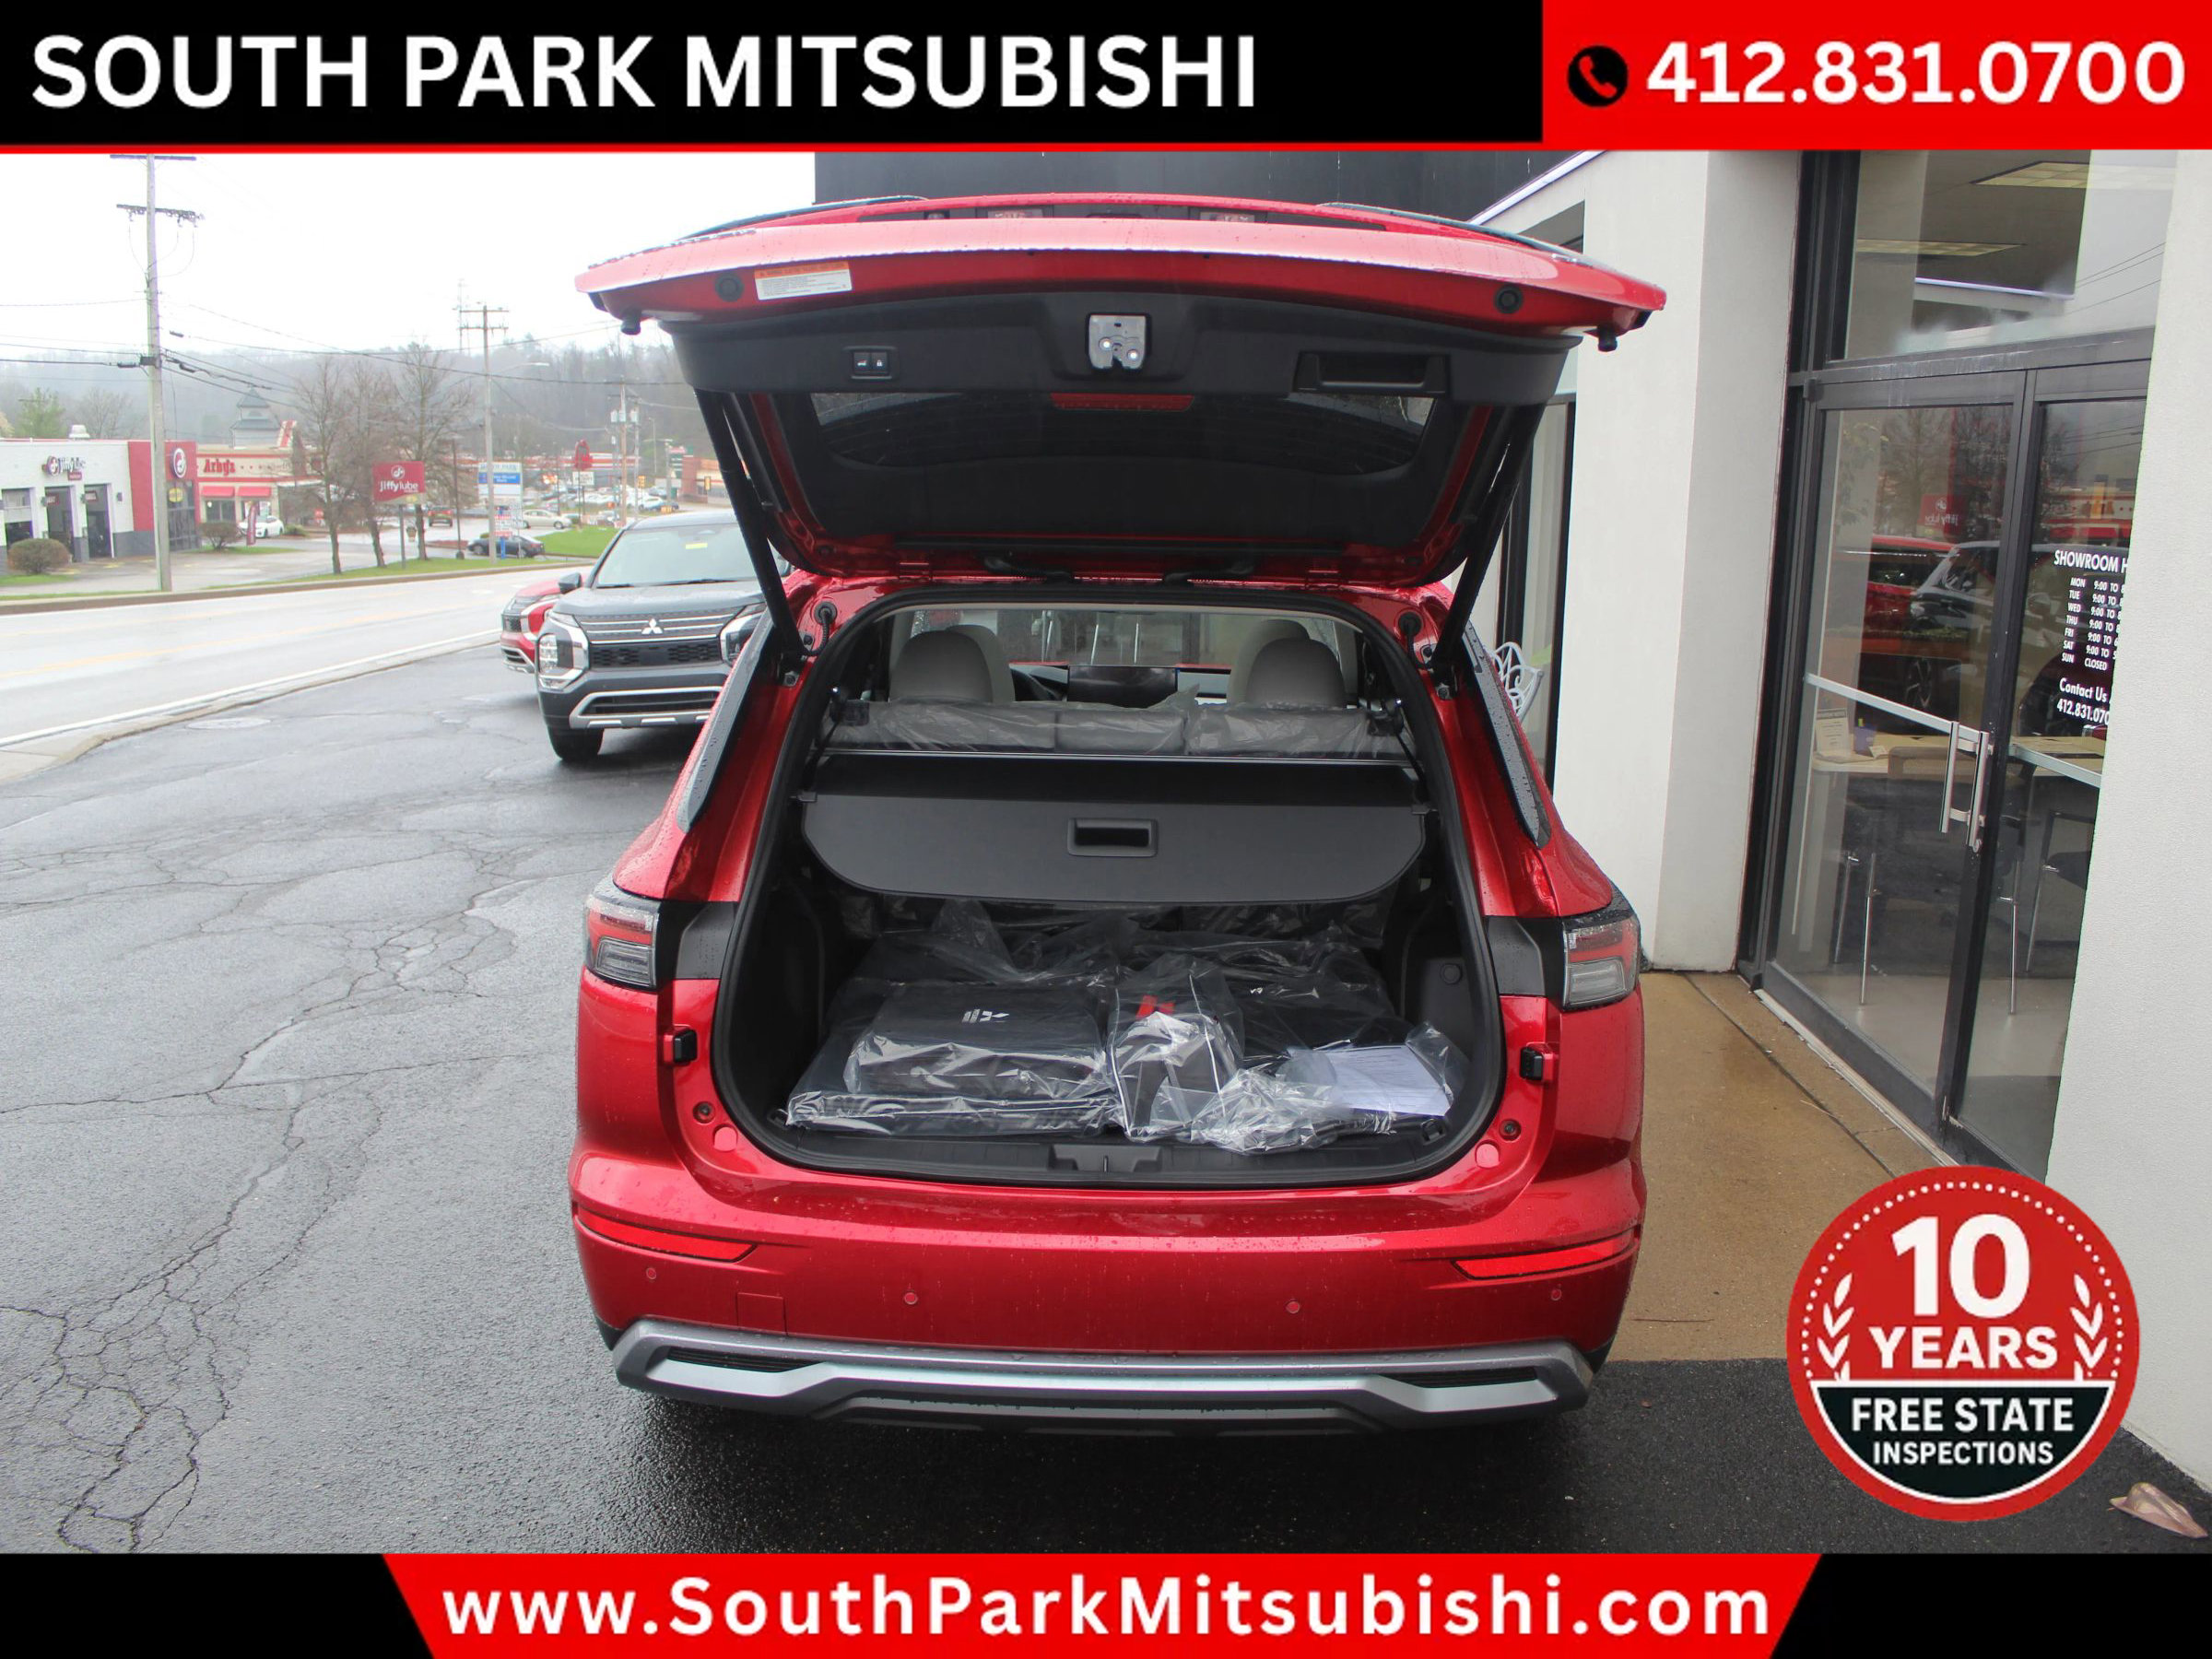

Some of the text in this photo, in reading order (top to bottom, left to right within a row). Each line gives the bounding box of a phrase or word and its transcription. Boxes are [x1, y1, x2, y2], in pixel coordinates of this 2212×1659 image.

[204, 458, 236, 476] Arby's
[2053, 550, 2119, 573] SHOWROOM
[2070, 577, 2086, 588] MON
[2094, 580, 2108, 591] 9:00
[2110, 582, 2119, 593] TO
[2069, 590, 2080, 600] TUE
[2092, 594, 2106, 605] 9:00
[2108, 595, 2117, 606] TO
[2067, 602, 2081, 613] WED
[2090, 606, 2104, 618] 9:00
[2106, 608, 2115, 619] TO
[2066, 615, 2078, 625] THU
[2089, 619, 2102, 630] 9:00
[2105, 621, 2113, 632] TO
[2065, 628, 2074, 638] FRI
[2088, 632, 2100, 643] 9:00
[2103, 635, 2112, 645] TO
[2063, 640, 2075, 651] SAT
[2086, 645, 2099, 655] 9:00
[2100, 647, 2110, 658] TO
[2061, 653, 2108, 671] SUN CLOSED
[2059, 677, 2108, 703] Contact Us
